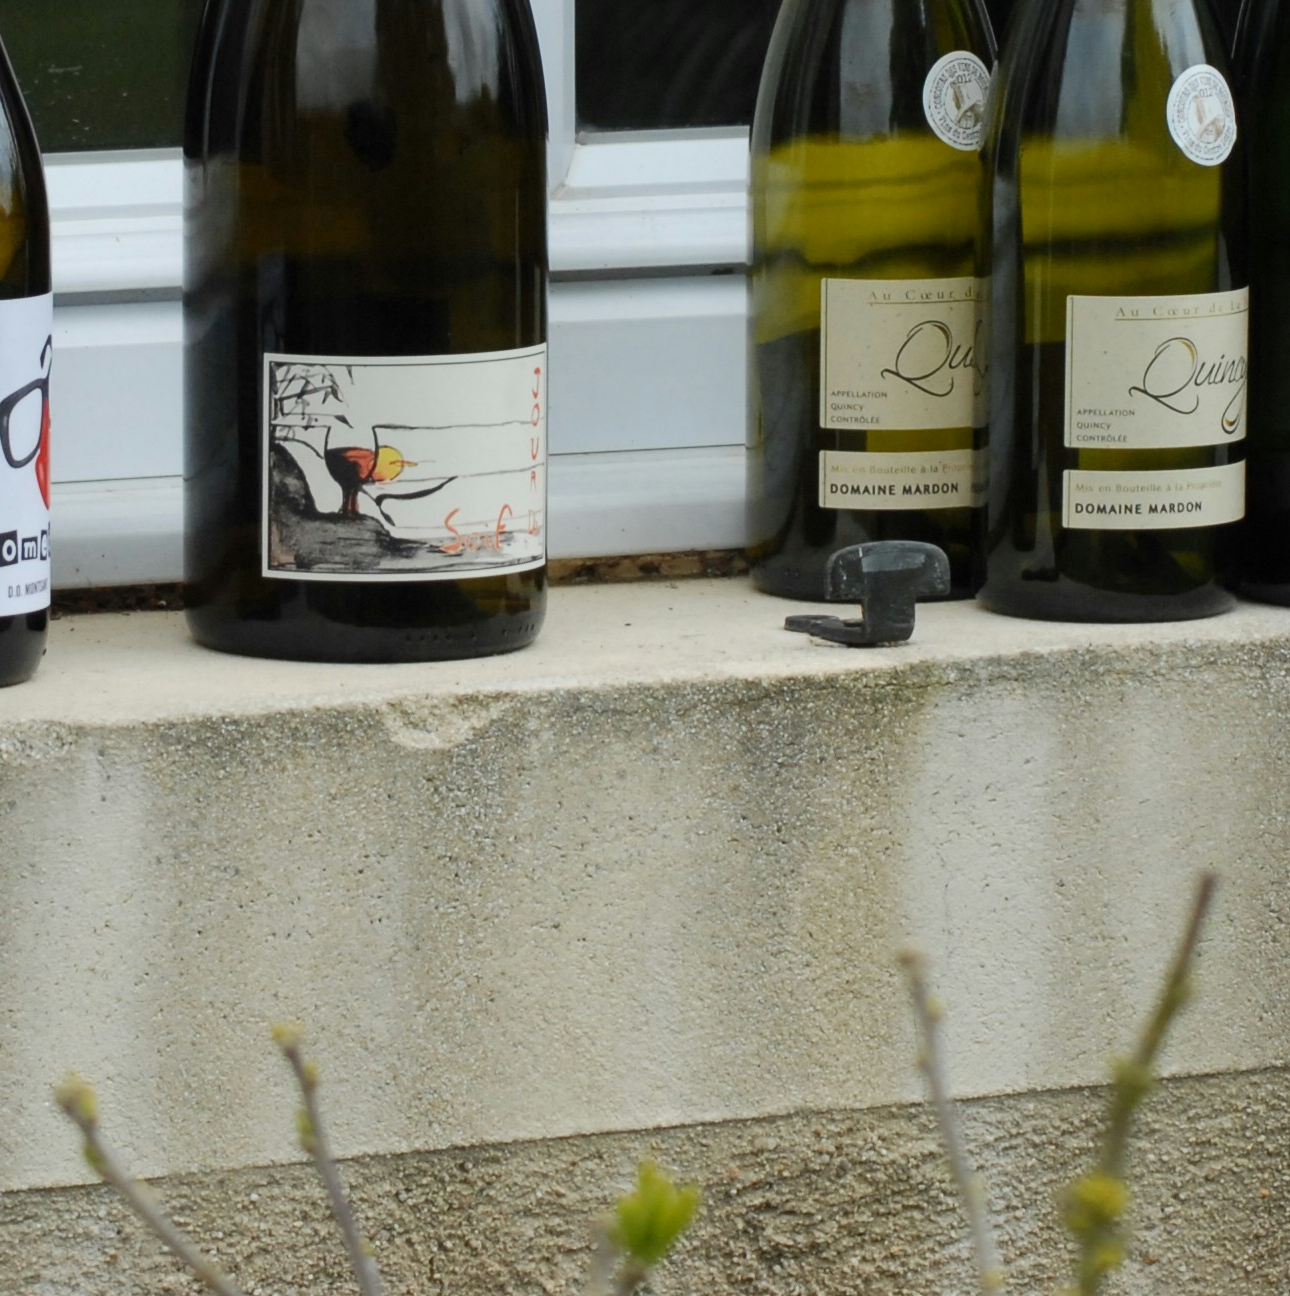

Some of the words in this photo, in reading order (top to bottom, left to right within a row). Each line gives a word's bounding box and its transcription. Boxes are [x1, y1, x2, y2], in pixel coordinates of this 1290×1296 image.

[869, 291, 892, 301] Au
[1116, 306, 1140, 317] Au
[831, 390, 888, 399] APPELLATION
[830, 404, 864, 413] QUINCY
[1077, 408, 1136, 417] APPELLATION
[830, 414, 880, 425] CONTRÔLÉE
[1076, 421, 1111, 430] QUINCY
[1076, 433, 1127, 443] CONTRÔLÉE
[870, 465, 916, 475] Bouteille
[930, 464, 939, 473] la
[830, 483, 896, 495] DOMAINE
[902, 482, 959, 495] MARDON
[1098, 485, 1112, 493] en
[1116, 482, 1161, 493] Bouteille
[1075, 503, 1143, 515] DOMAINE
[1149, 502, 1202, 514] MARDON
